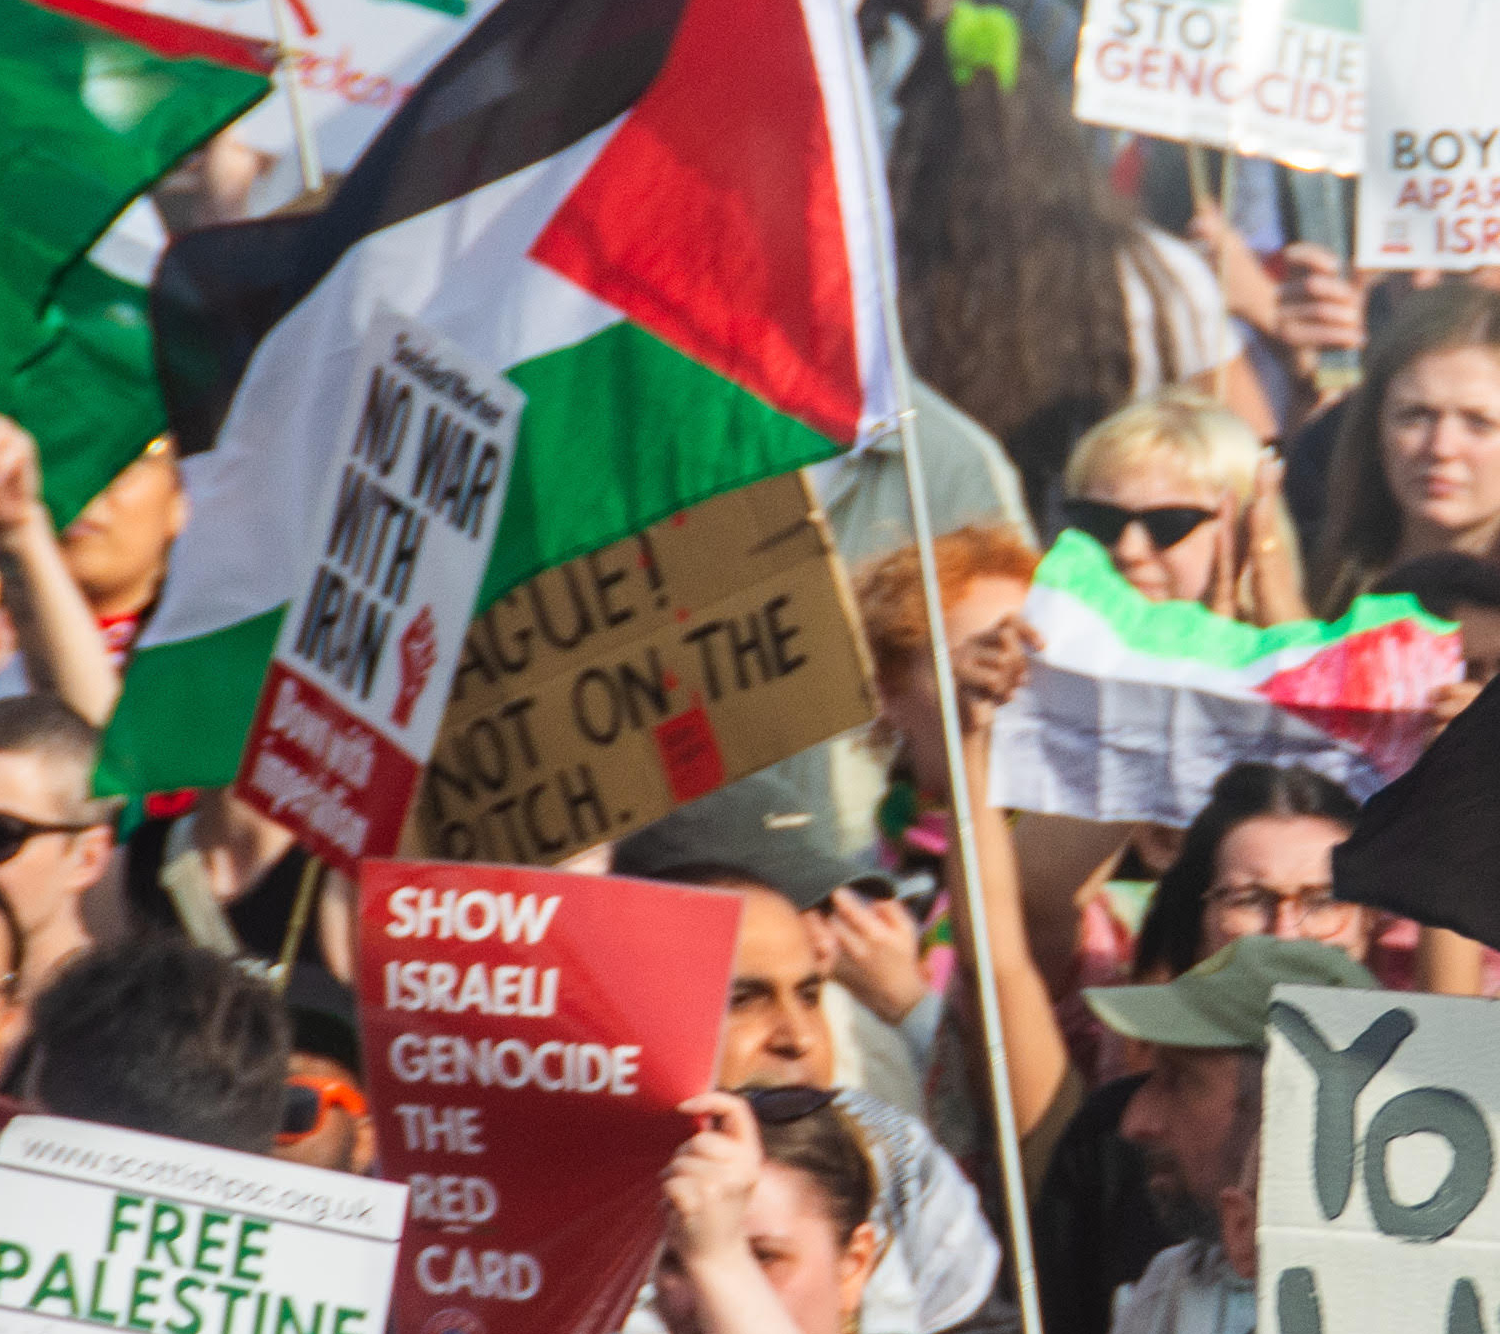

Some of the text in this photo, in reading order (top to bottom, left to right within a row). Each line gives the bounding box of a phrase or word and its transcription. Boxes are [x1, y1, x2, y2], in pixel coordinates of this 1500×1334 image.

[352, 365, 501, 541] NO WAR
[325, 462, 429, 607] WITH
[293, 563, 396, 702] IRAN
[571, 645, 671, 746] ON
[681, 593, 808, 703] THE
[385, 885, 563, 946] SHOW
[384, 960, 560, 1018] ISRAELI
[389, 1034, 644, 1096] GENOCIDE
[395, 1103, 486, 1155] THE
[409, 1175, 498, 1224] RED
[106, 1189, 272, 1282] FREE
[415, 1245, 542, 1302] CARD
